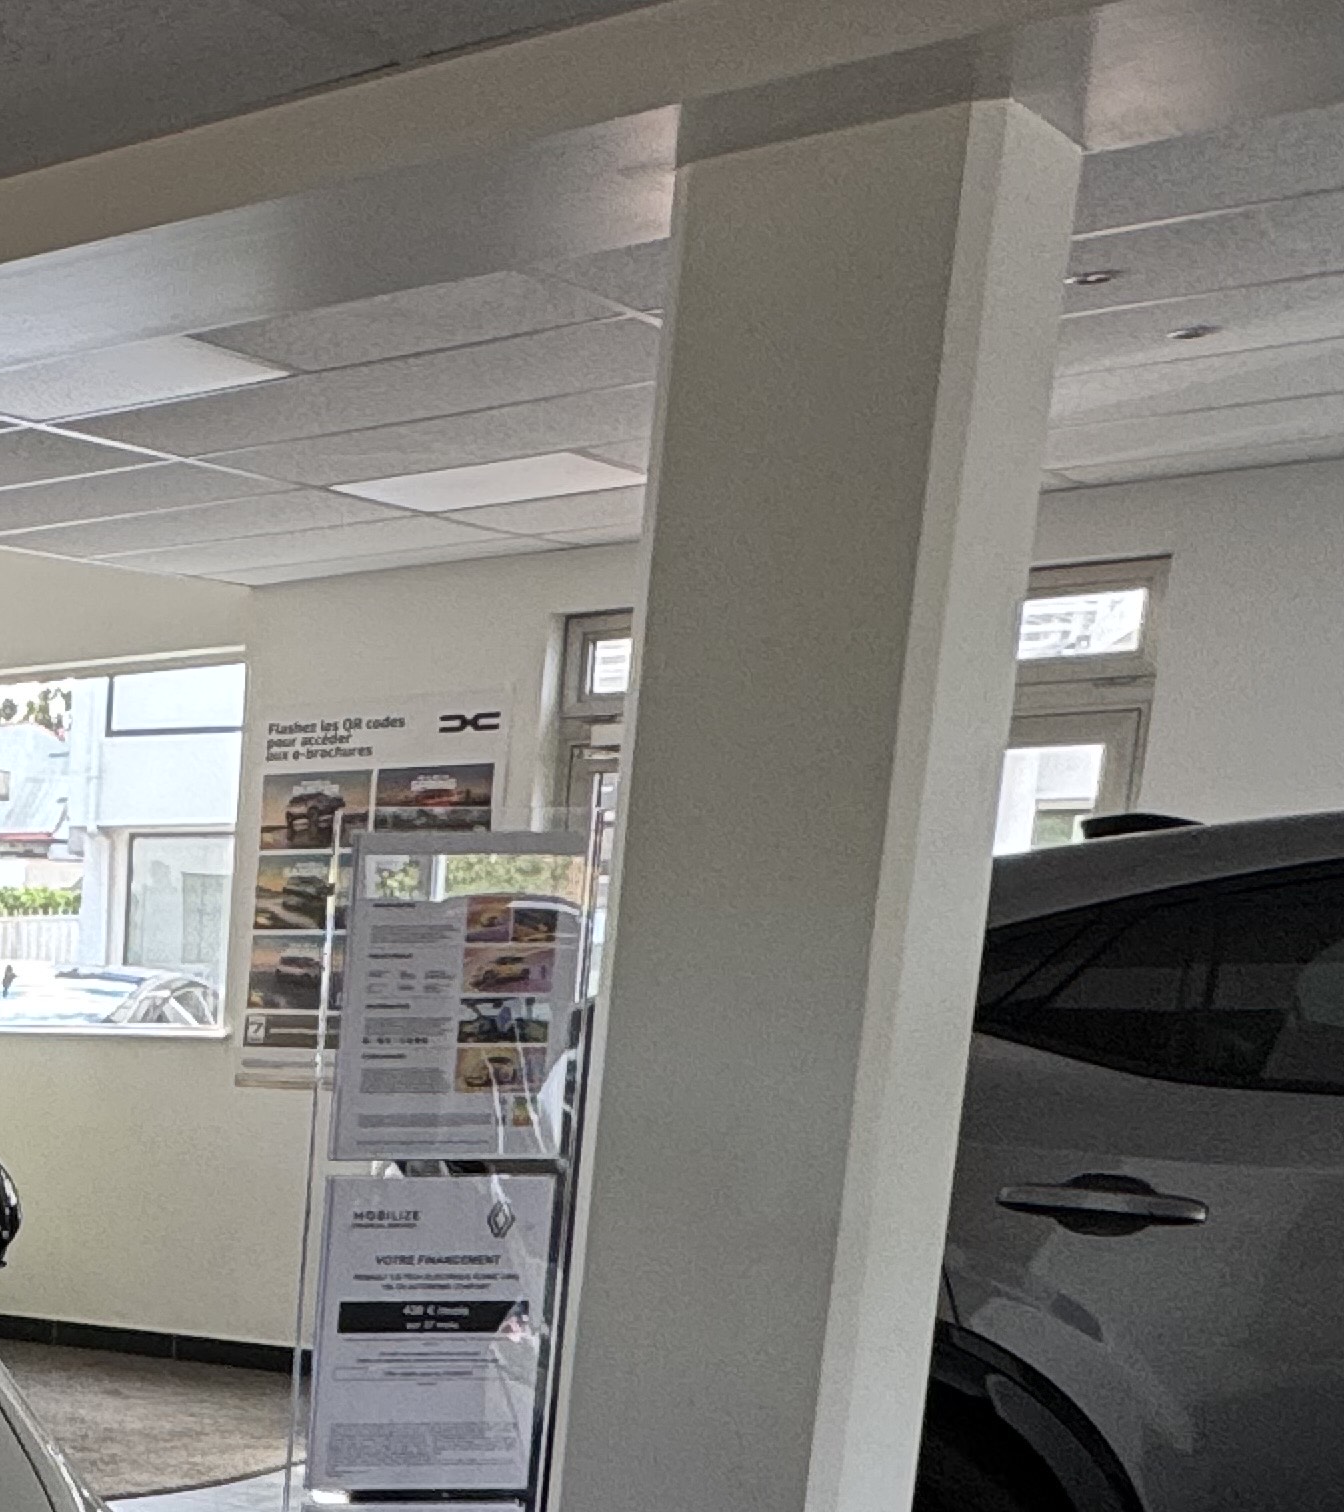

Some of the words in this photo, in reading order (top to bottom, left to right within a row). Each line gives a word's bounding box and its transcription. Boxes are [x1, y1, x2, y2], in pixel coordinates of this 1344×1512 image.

[321, 719, 339, 732] les
[342, 717, 362, 732] QR
[366, 716, 406, 730] codes
[353, 1210, 421, 1221] MOBILIZE
[375, 1254, 416, 1266] VOTRE
[417, 1254, 501, 1266] FINANCEMENT
